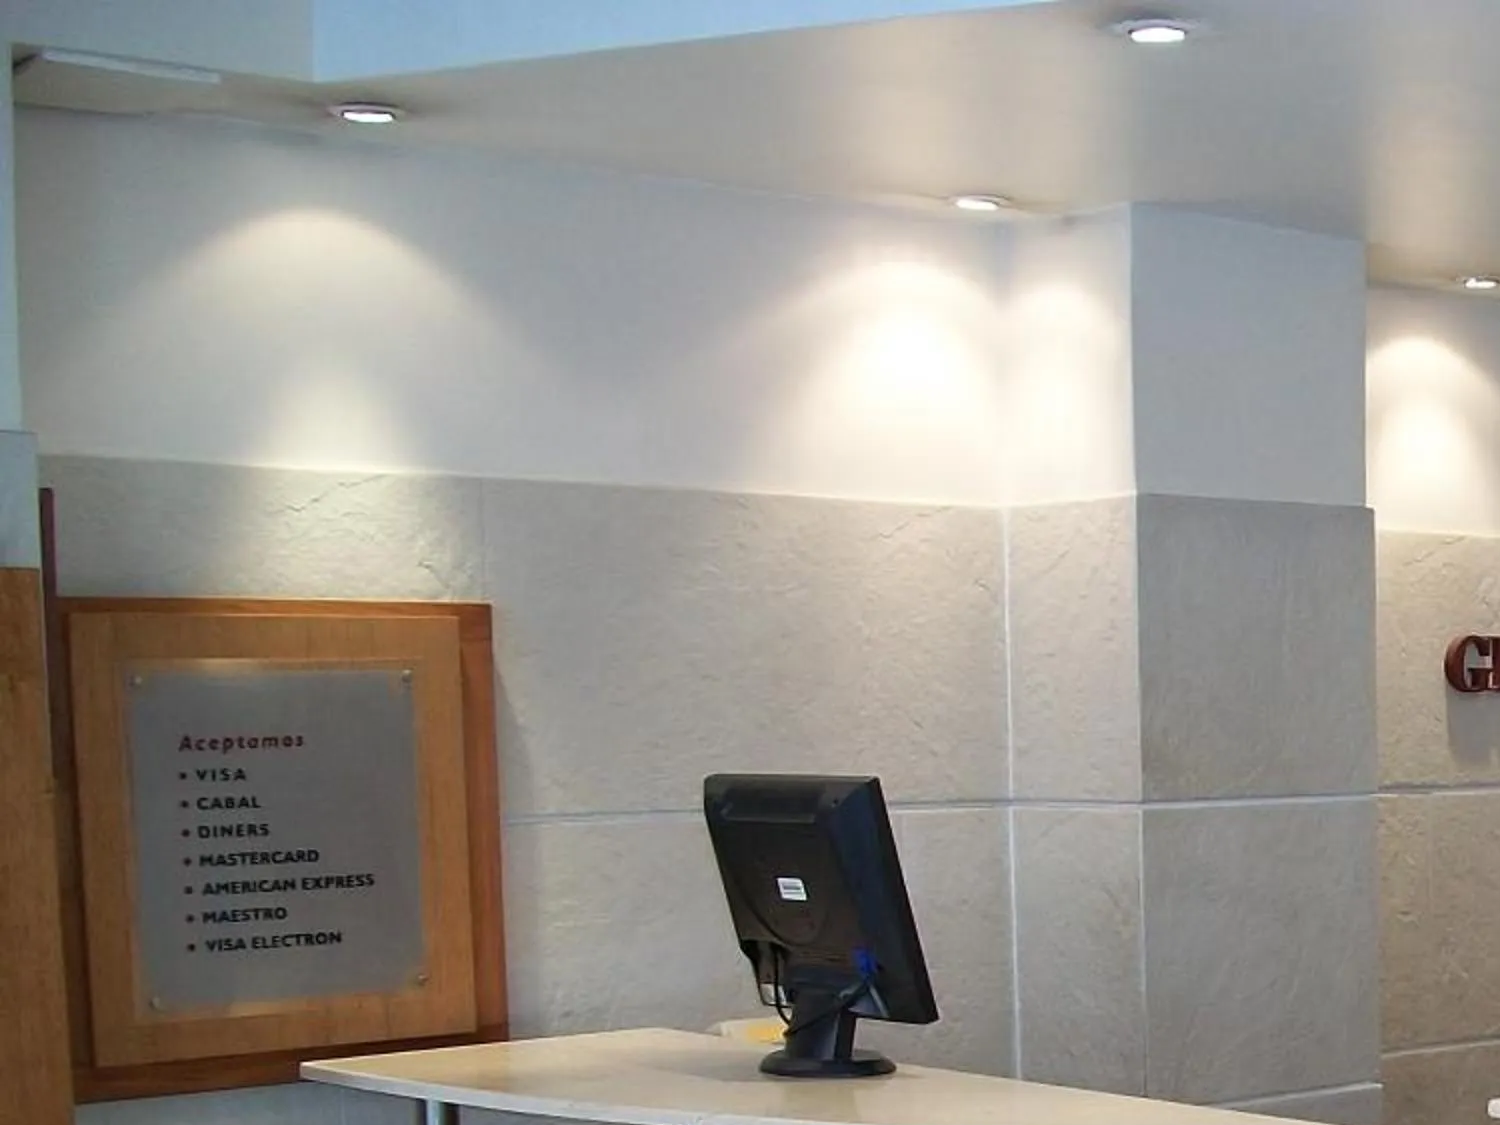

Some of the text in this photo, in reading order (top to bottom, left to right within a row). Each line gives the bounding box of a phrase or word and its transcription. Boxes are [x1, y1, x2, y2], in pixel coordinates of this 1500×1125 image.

[178, 733, 305, 753] Aceptamos
[196, 768, 247, 782] VISA
[196, 796, 262, 811] CABAL
[197, 823, 270, 839] DINERS
[199, 849, 320, 868] MASTERCARD
[202, 873, 375, 896] AMERICAN EXPRESS
[202, 907, 288, 924] MAESTRO
[205, 931, 342, 953] VISA ELECTRON
